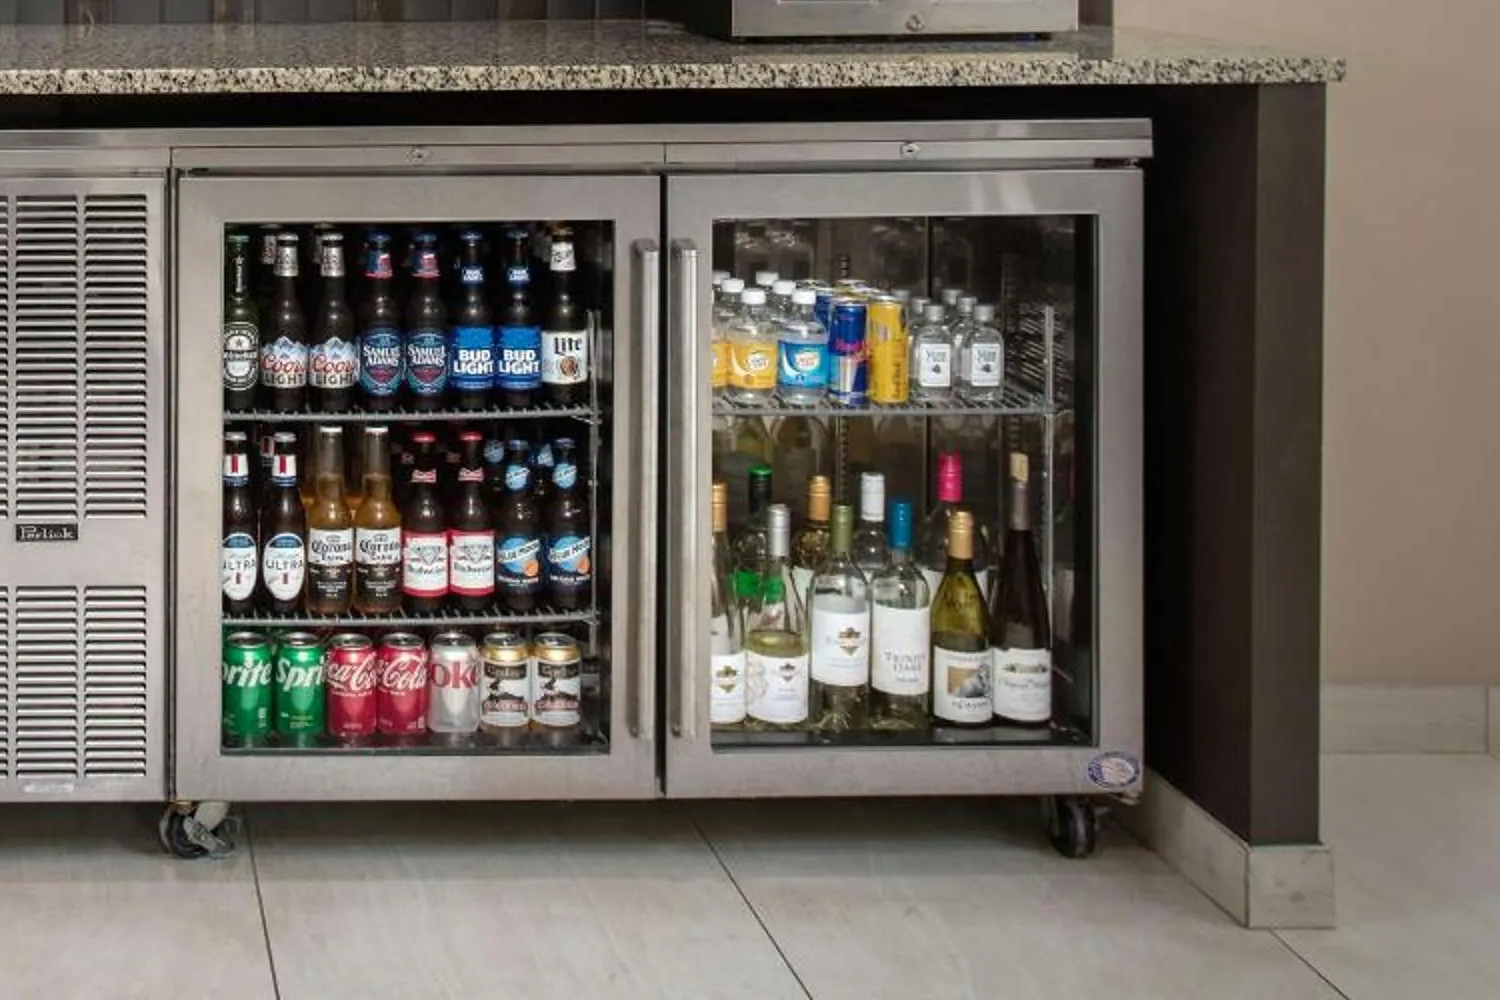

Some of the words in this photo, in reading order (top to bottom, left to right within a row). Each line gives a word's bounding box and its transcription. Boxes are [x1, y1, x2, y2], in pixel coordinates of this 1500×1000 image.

[459, 350, 491, 361] BUD
[503, 350, 536, 361] BUD
[453, 360, 494, 375] LIGHT
[499, 360, 540, 375] LIGHT
